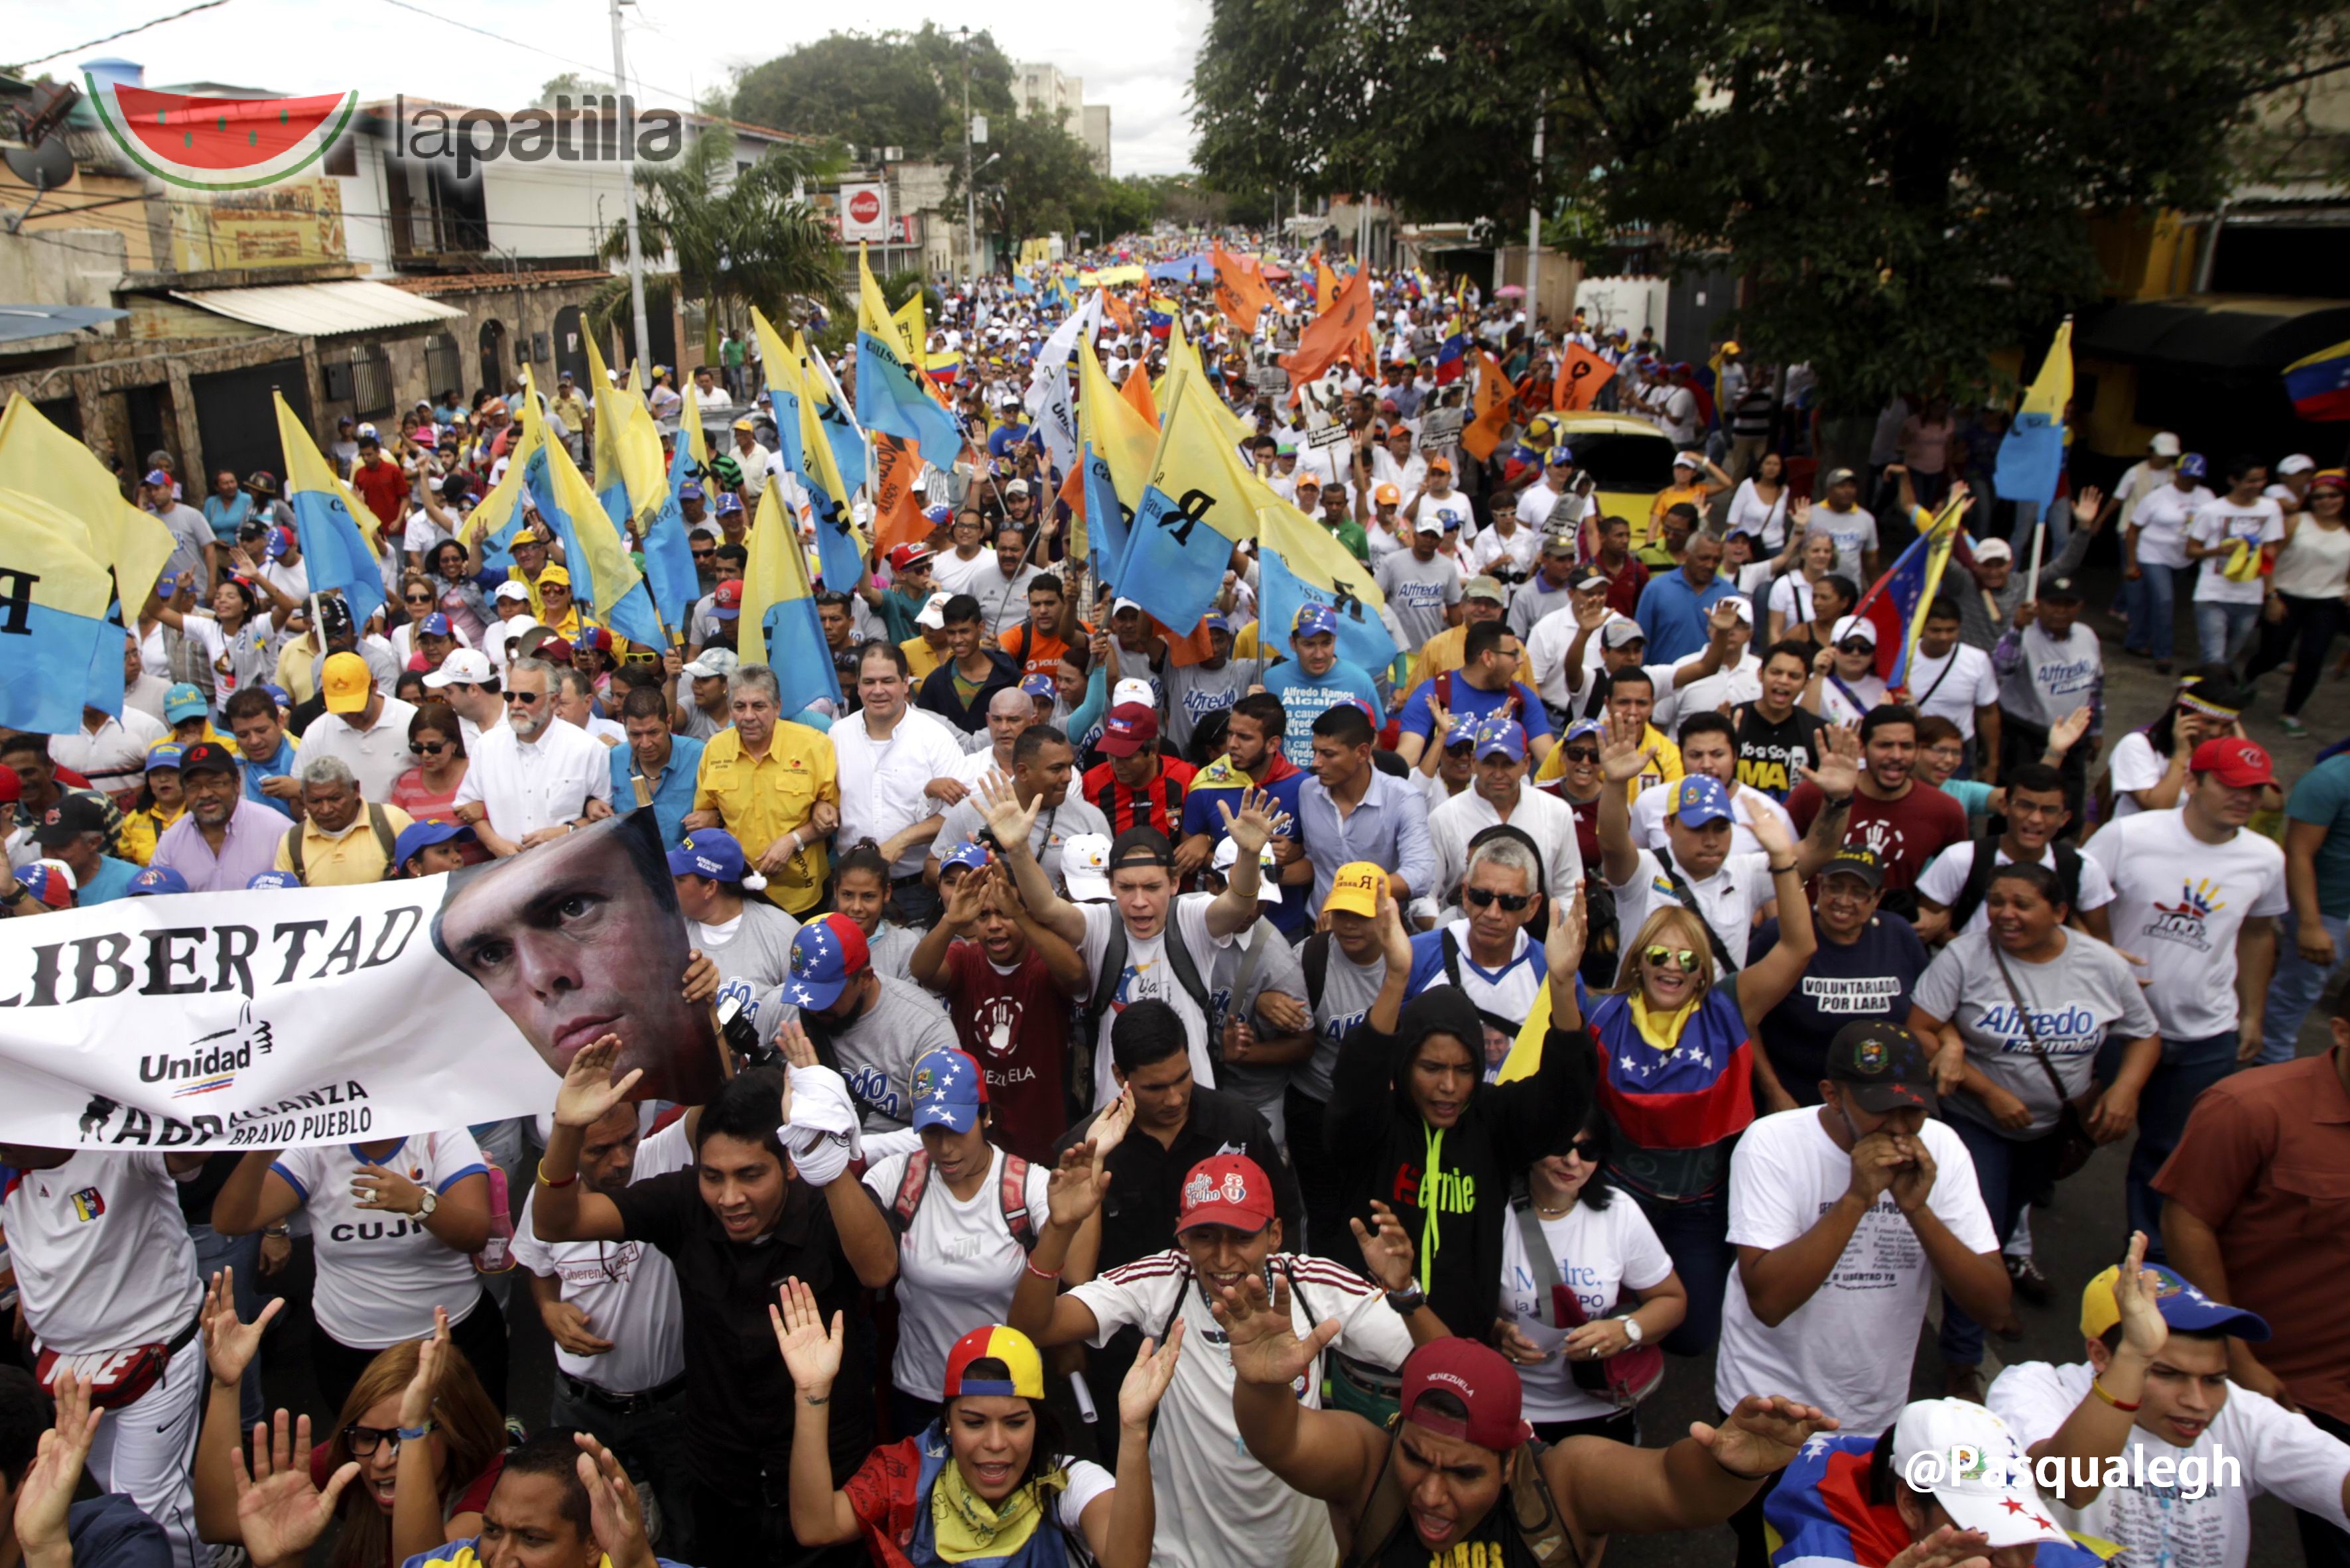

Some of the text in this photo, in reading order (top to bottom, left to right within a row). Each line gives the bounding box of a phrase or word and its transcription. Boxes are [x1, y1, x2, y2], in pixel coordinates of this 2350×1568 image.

[1283, 686, 1355, 700] Alfredo Ramos
[0, 906, 423, 1008] IBERTAD
[1804, 978, 1900, 995] VOLUNTARIADO
[1821, 996, 1888, 1010] POR LARA
[1977, 1005, 2095, 1036] Alfredo
[140, 1041, 251, 1082] Unidad
[228, 1106, 371, 1146] BRAVO PUEBLO
[943, 1234, 981, 1266] RUN
[1514, 1258, 1603, 1293] Mdre,
[42, 1347, 141, 1385] NIKE
[1427, 1372, 1474, 1398] VENEZUELA
